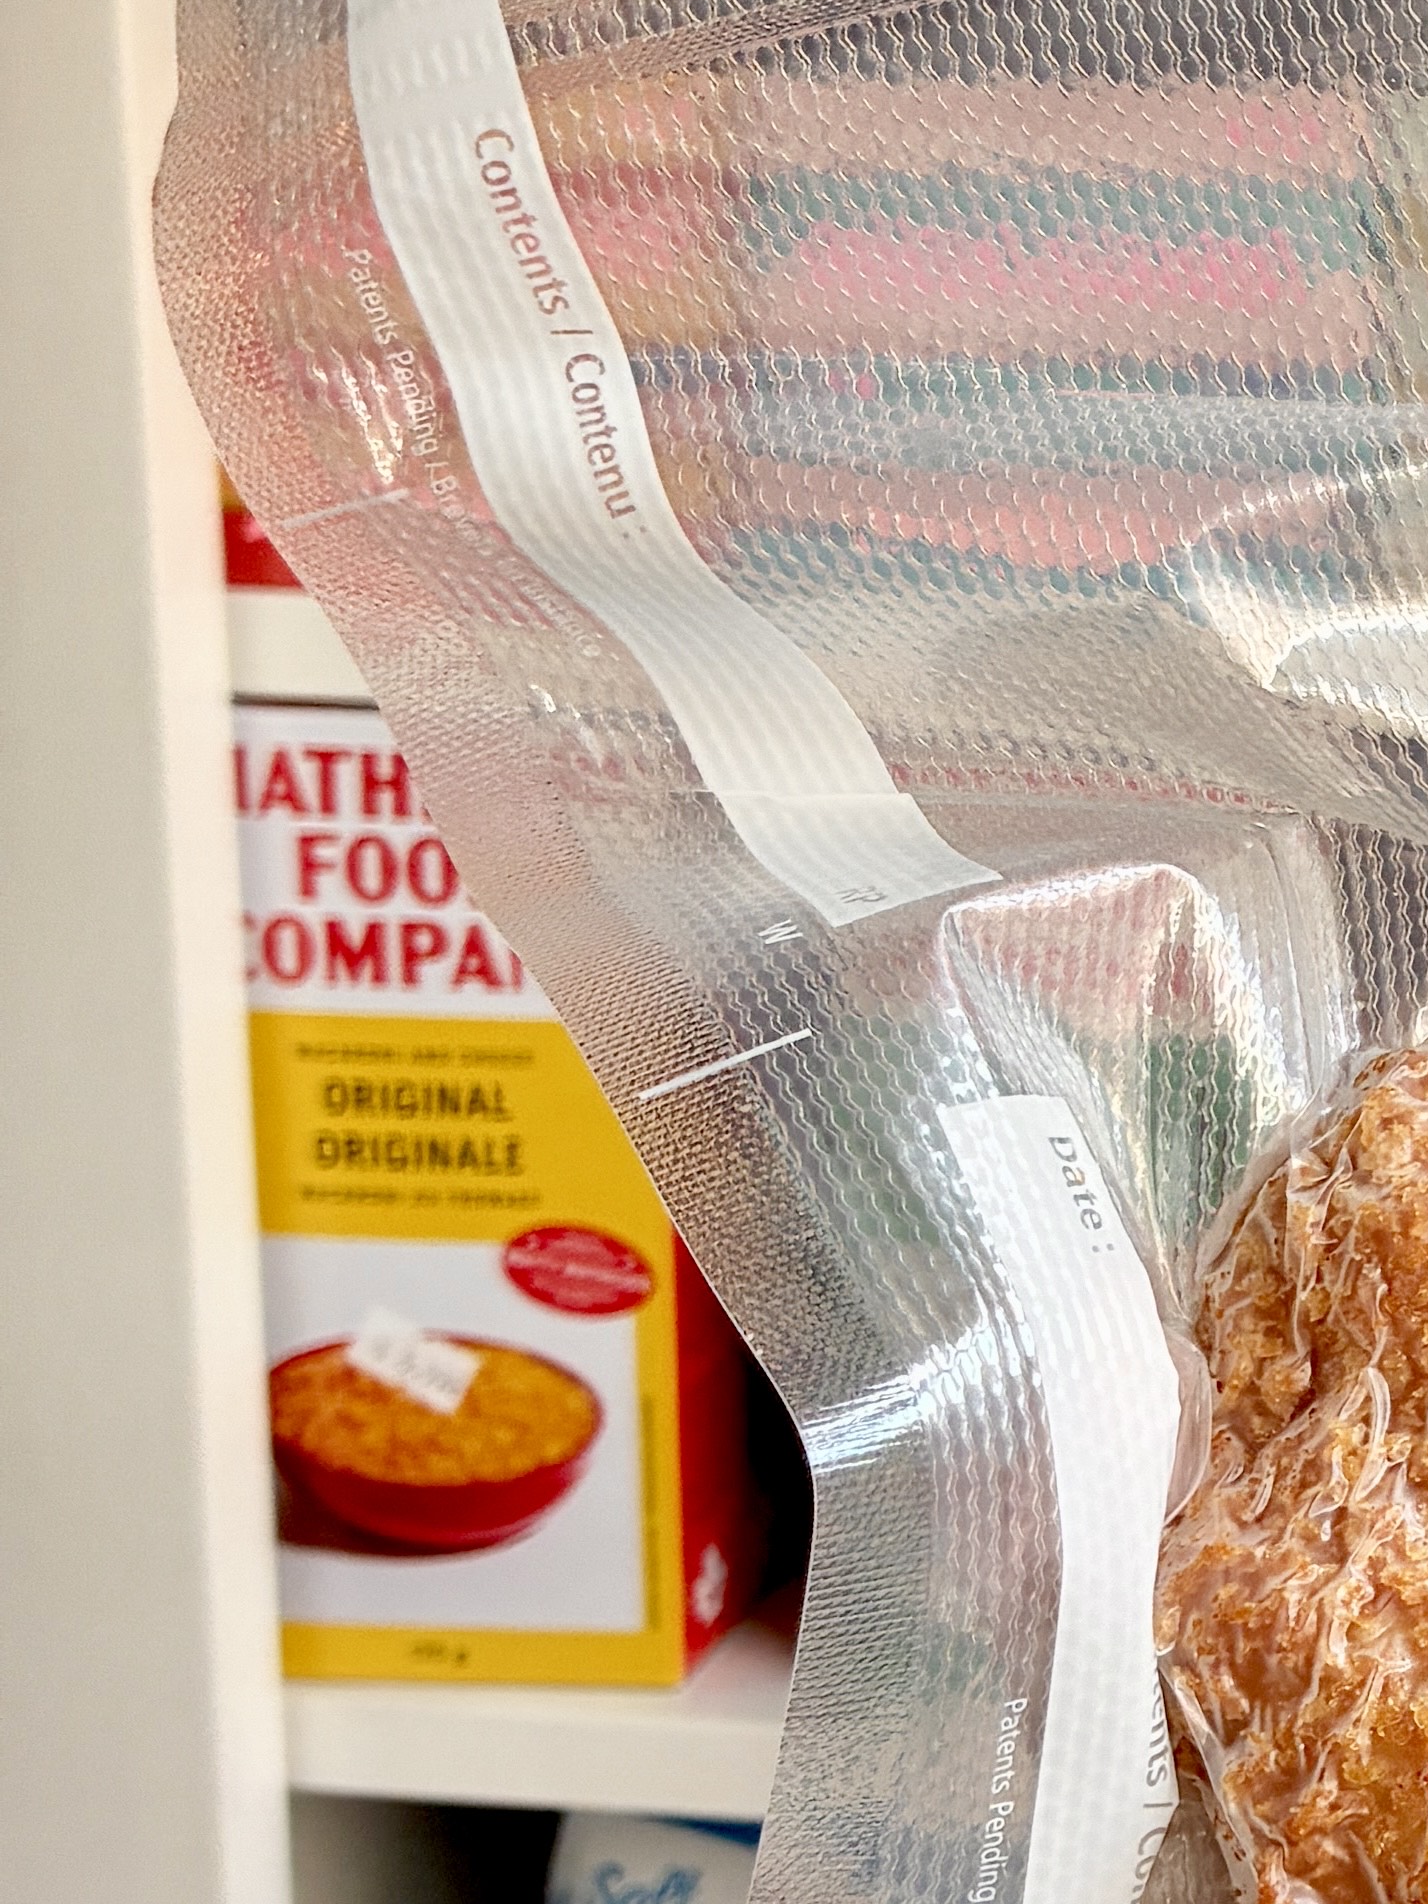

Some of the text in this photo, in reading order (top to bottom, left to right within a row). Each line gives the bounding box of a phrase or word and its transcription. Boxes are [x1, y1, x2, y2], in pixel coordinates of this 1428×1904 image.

[472, 124, 571, 319] Contents
[565, 352, 637, 520] Contenu
[243, 913, 524, 990] OMPA
[322, 1075, 513, 1124] ORIGINAL
[314, 1127, 526, 1177] ORIGINALE
[1046, 1132, 1103, 1233] Date
[996, 1697, 1029, 1793] Patents
